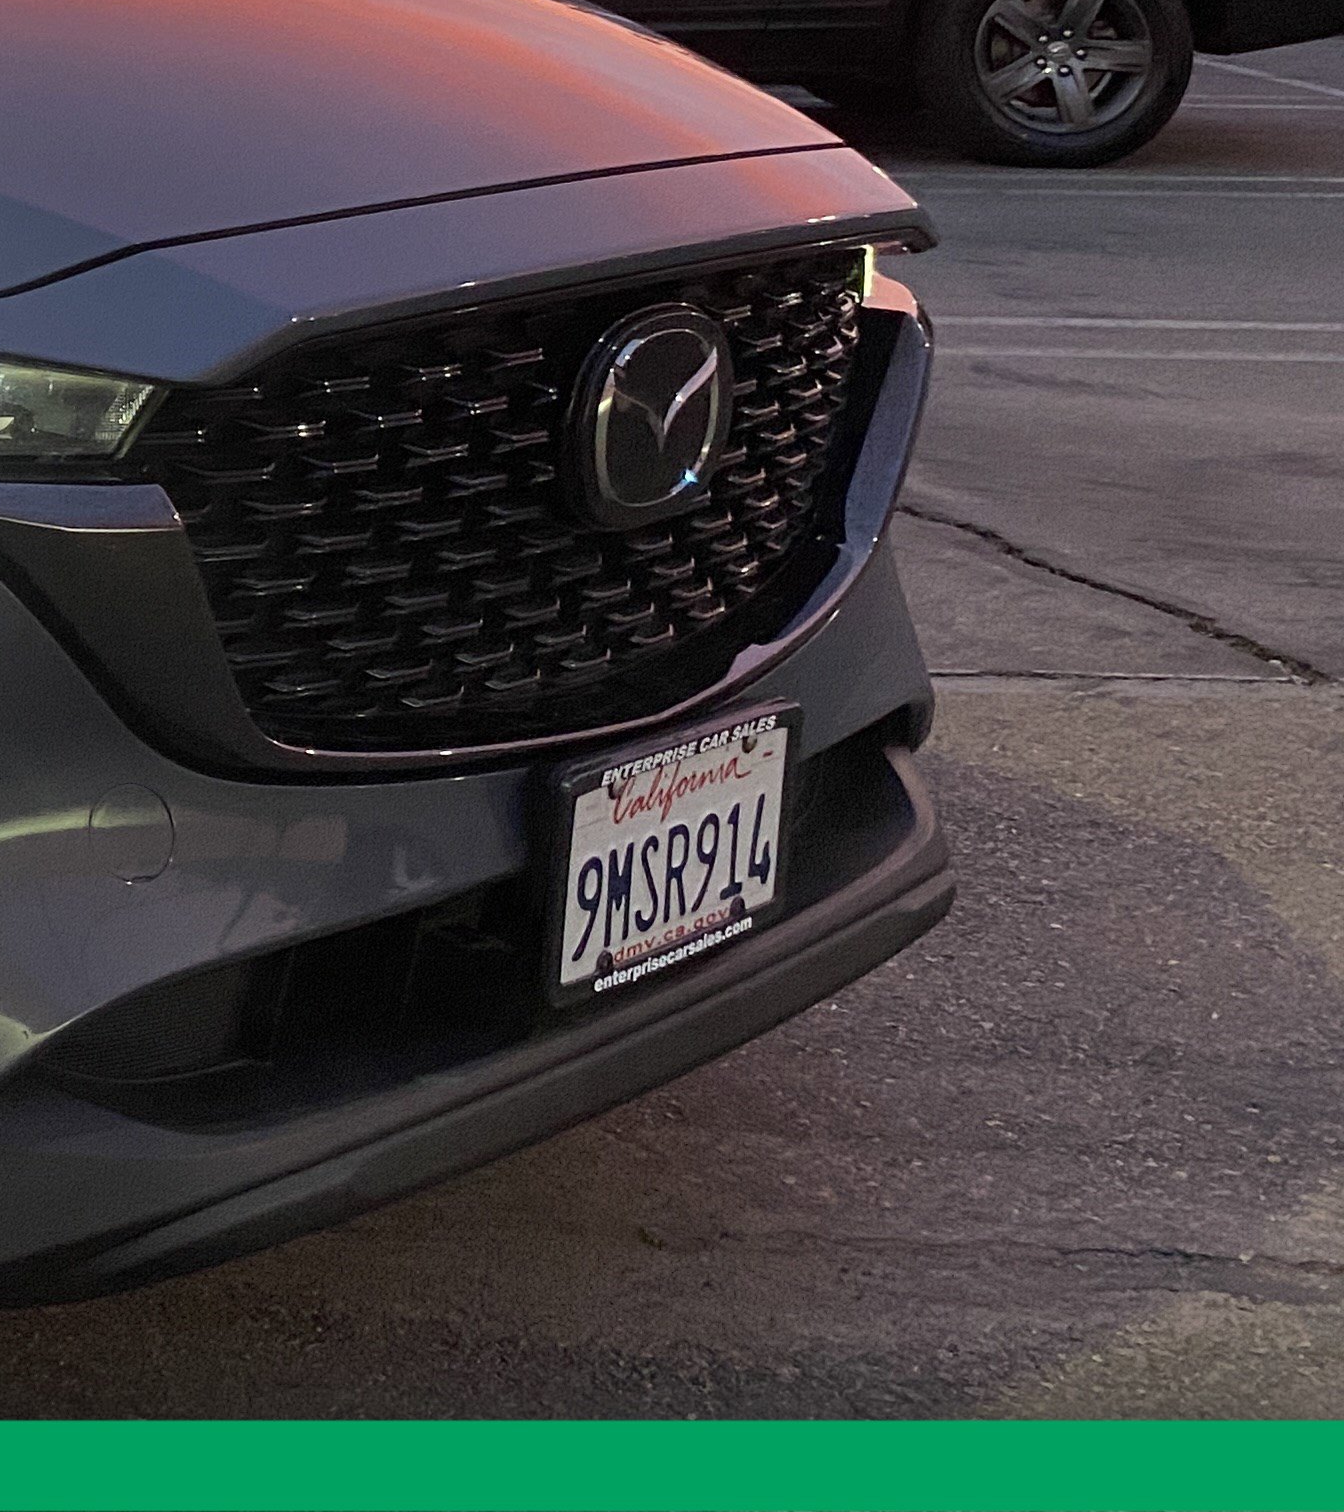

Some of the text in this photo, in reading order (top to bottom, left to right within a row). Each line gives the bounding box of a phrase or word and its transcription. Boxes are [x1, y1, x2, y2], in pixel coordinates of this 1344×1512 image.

[600, 714, 778, 788] ENTERPRISE CAR SALES
[613, 756, 752, 825] California
[571, 793, 772, 963] 9MSR914
[593, 915, 754, 992] enterprisecarsales.com
[613, 905, 730, 964] dmv.ca.gov
